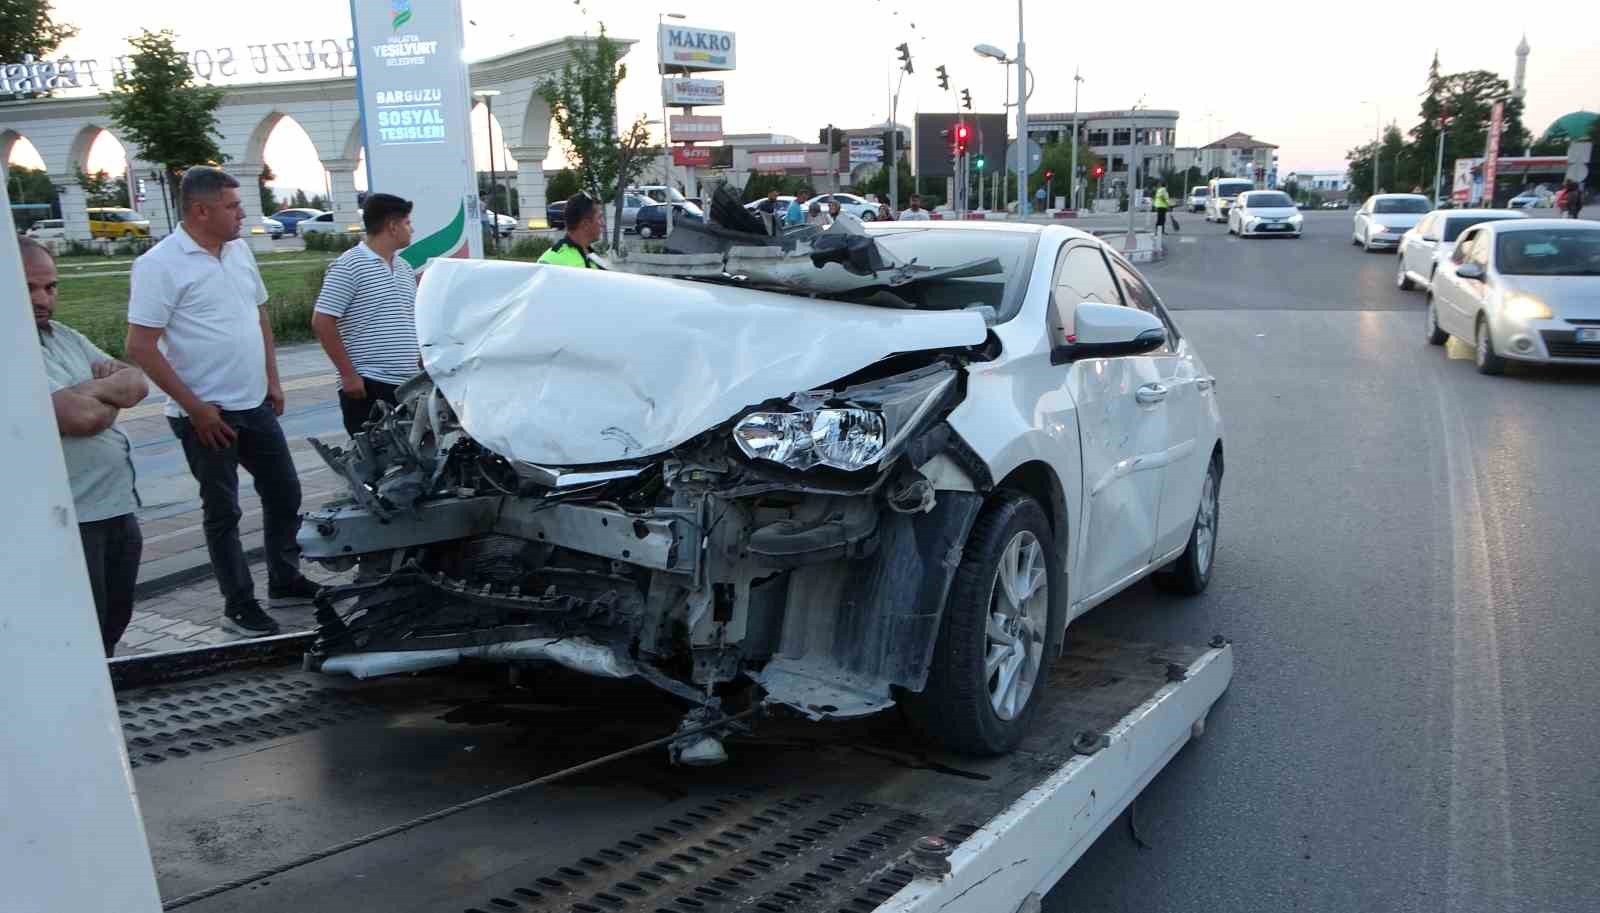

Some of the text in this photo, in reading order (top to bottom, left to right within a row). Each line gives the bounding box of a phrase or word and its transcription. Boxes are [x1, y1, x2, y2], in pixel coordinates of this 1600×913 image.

[668, 29, 731, 51] MAKRO
[376, 88, 441, 104] BARGUZU
[378, 109, 444, 126] SOSYAL
